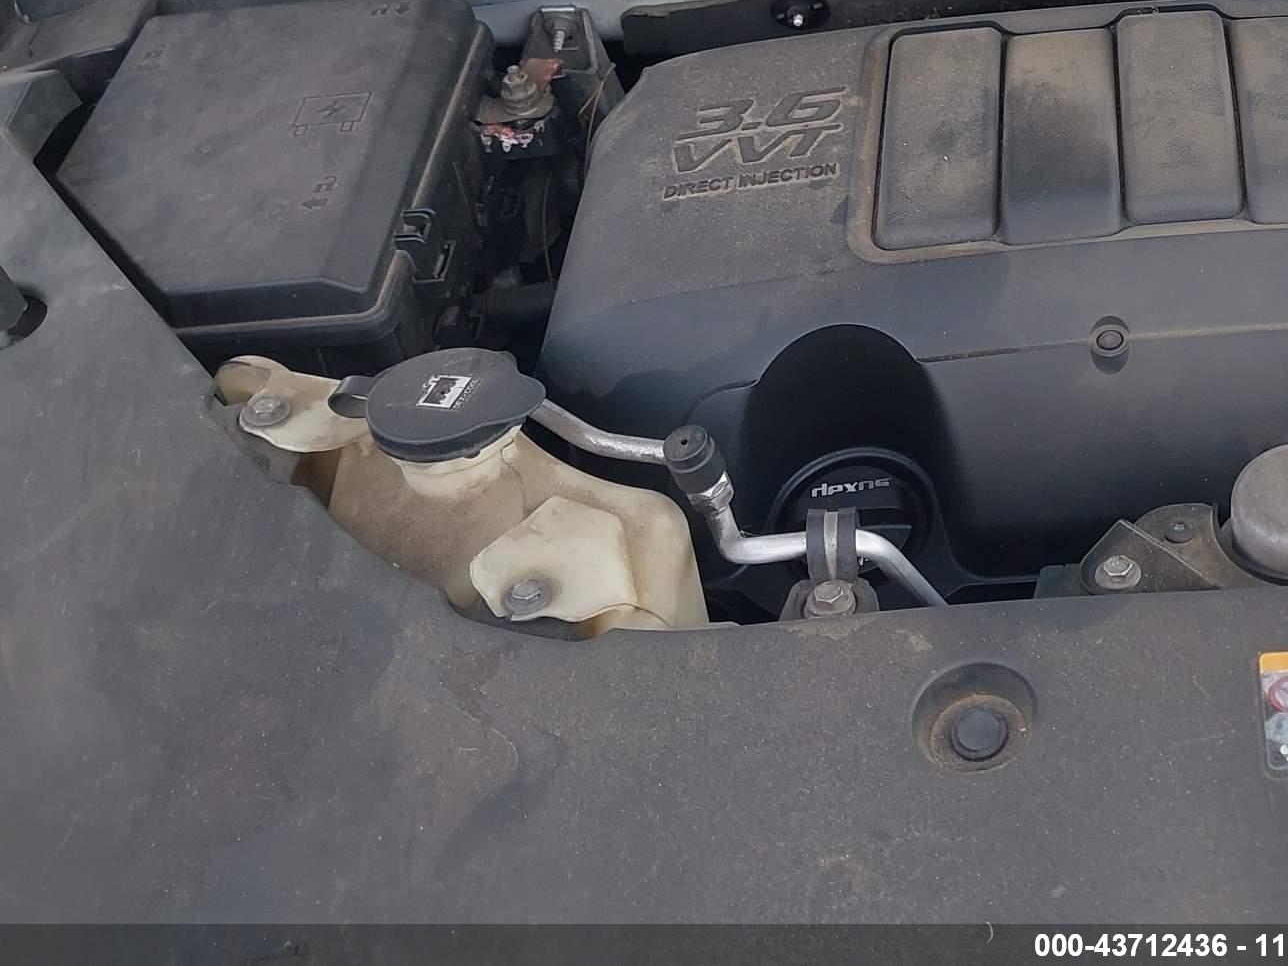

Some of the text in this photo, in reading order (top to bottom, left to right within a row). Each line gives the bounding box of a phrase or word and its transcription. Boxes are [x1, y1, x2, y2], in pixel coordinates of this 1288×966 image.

[675, 86, 848, 141] 3.6
[674, 124, 843, 173] VVT
[663, 163, 837, 199] DIRECT INJECTION
